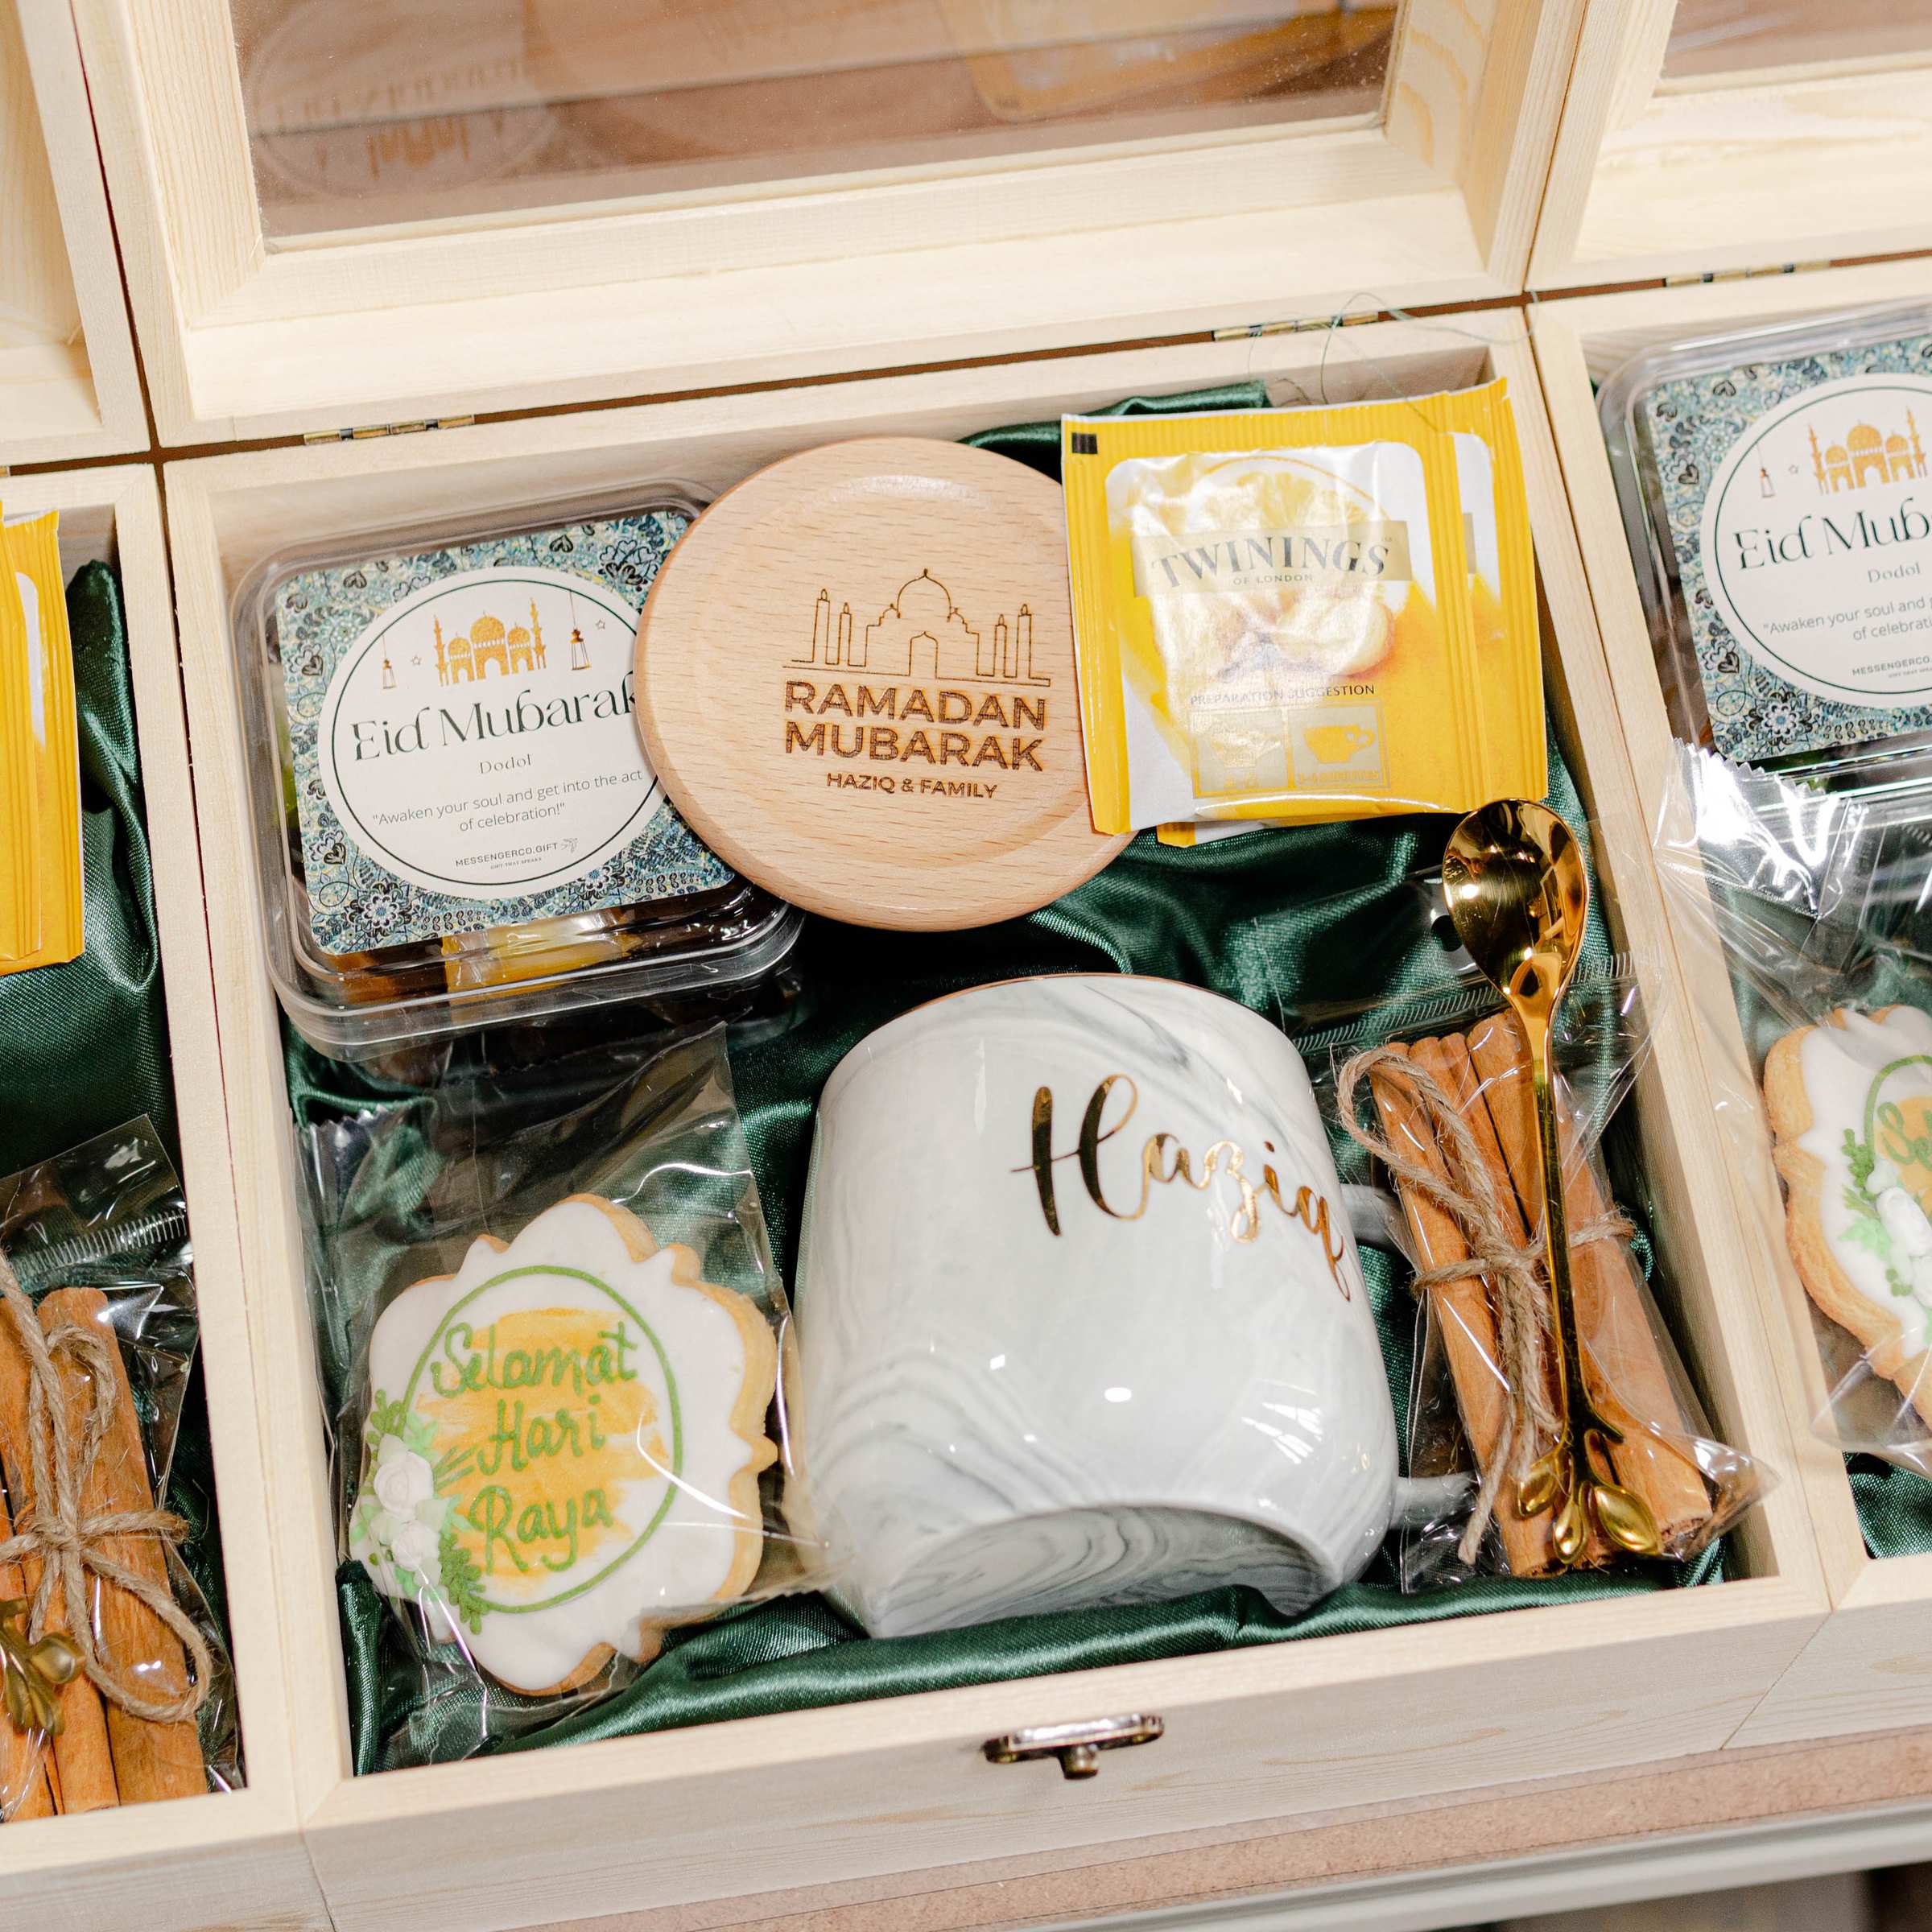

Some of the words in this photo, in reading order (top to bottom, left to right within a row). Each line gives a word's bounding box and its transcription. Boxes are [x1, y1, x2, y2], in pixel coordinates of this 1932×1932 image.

[1733, 514, 1813, 570] Eid
[1822, 496, 1932, 555] Mub
[1152, 536, 1390, 588] TWININGS
[1232, 576, 1250, 586] OF
[1256, 573, 1313, 584] LONDON
[1867, 562, 1922, 584] Dodol
[1763, 615, 1824, 635] "Awaken
[1827, 609, 1860, 629] your
[1864, 601, 1894, 619] soul
[1898, 596, 1926, 613] and
[1852, 629, 1867, 641] of
[784, 679, 1046, 732] RAMADAN
[1190, 690, 1284, 705] PREPARATION
[1288, 684, 1376, 700] SUGGESTION
[349, 705, 431, 762] Eid
[785, 720, 1044, 772] MUBARAK
[479, 753, 531, 774] Dodol
[827, 772, 895, 795] HAZIQ
[900, 778, 914, 794] &
[920, 778, 998, 799] FAMILY
[373, 807, 433, 825] "Awaken
[436, 801, 469, 819] your
[473, 793, 502, 810] soul
[506, 787, 533, 804] and
[537, 785, 560, 802] get
[563, 780, 591, 794] into
[594, 774, 617, 788] the
[621, 770, 643, 783] act
[460, 817, 474, 832] of
[477, 802, 565, 829] celebration!"
[455, 843, 559, 866] MESSENGERCO.GIFT
[1010, 1074, 1351, 1302] Haziq
[431, 1319, 639, 1398] Selamat
[477, 1393, 606, 1476] Hari
[469, 1485, 614, 1576] Raya
